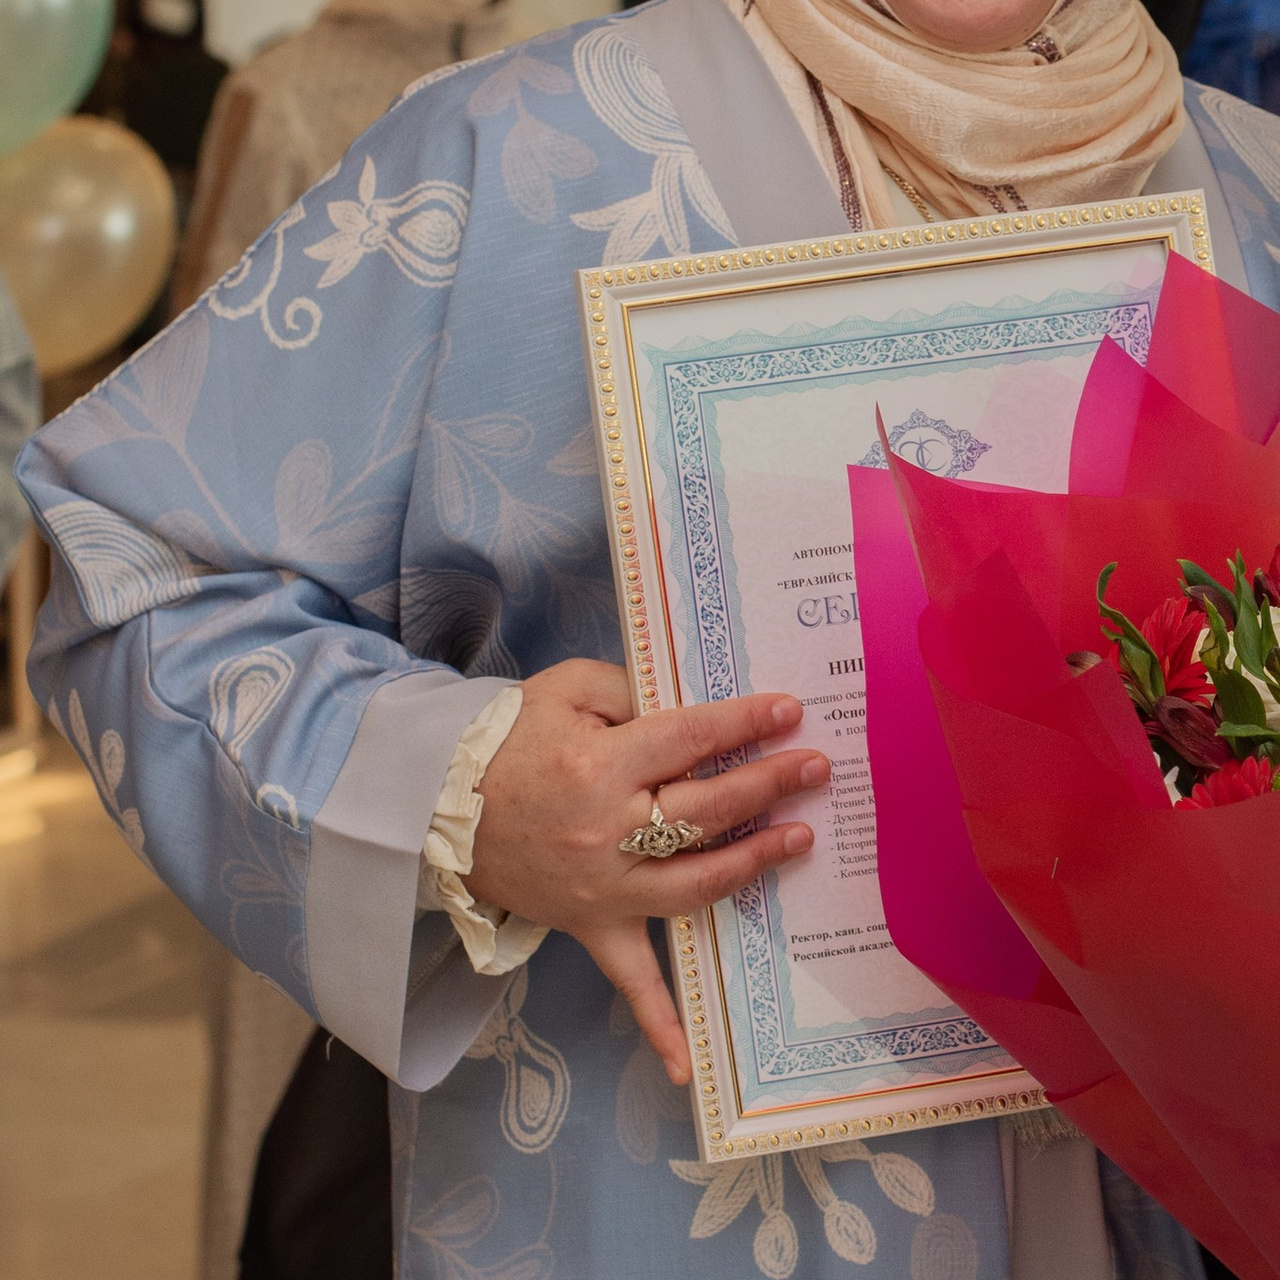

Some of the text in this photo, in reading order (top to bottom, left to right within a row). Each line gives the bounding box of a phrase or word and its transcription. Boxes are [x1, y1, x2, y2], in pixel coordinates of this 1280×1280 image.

[793, 543, 854, 560] АВТОНОМ
[777, 571, 856, 590] “ЕВРАЗИЙСК
[799, 693, 843, 707] спешно
[831, 798, 866, 810] Чтение
[833, 811, 876, 825] Духовно
[835, 825, 875, 837] История
[791, 932, 833, 944] Ректор,
[834, 927, 864, 937] канд.
[793, 945, 856, 962] Российской
